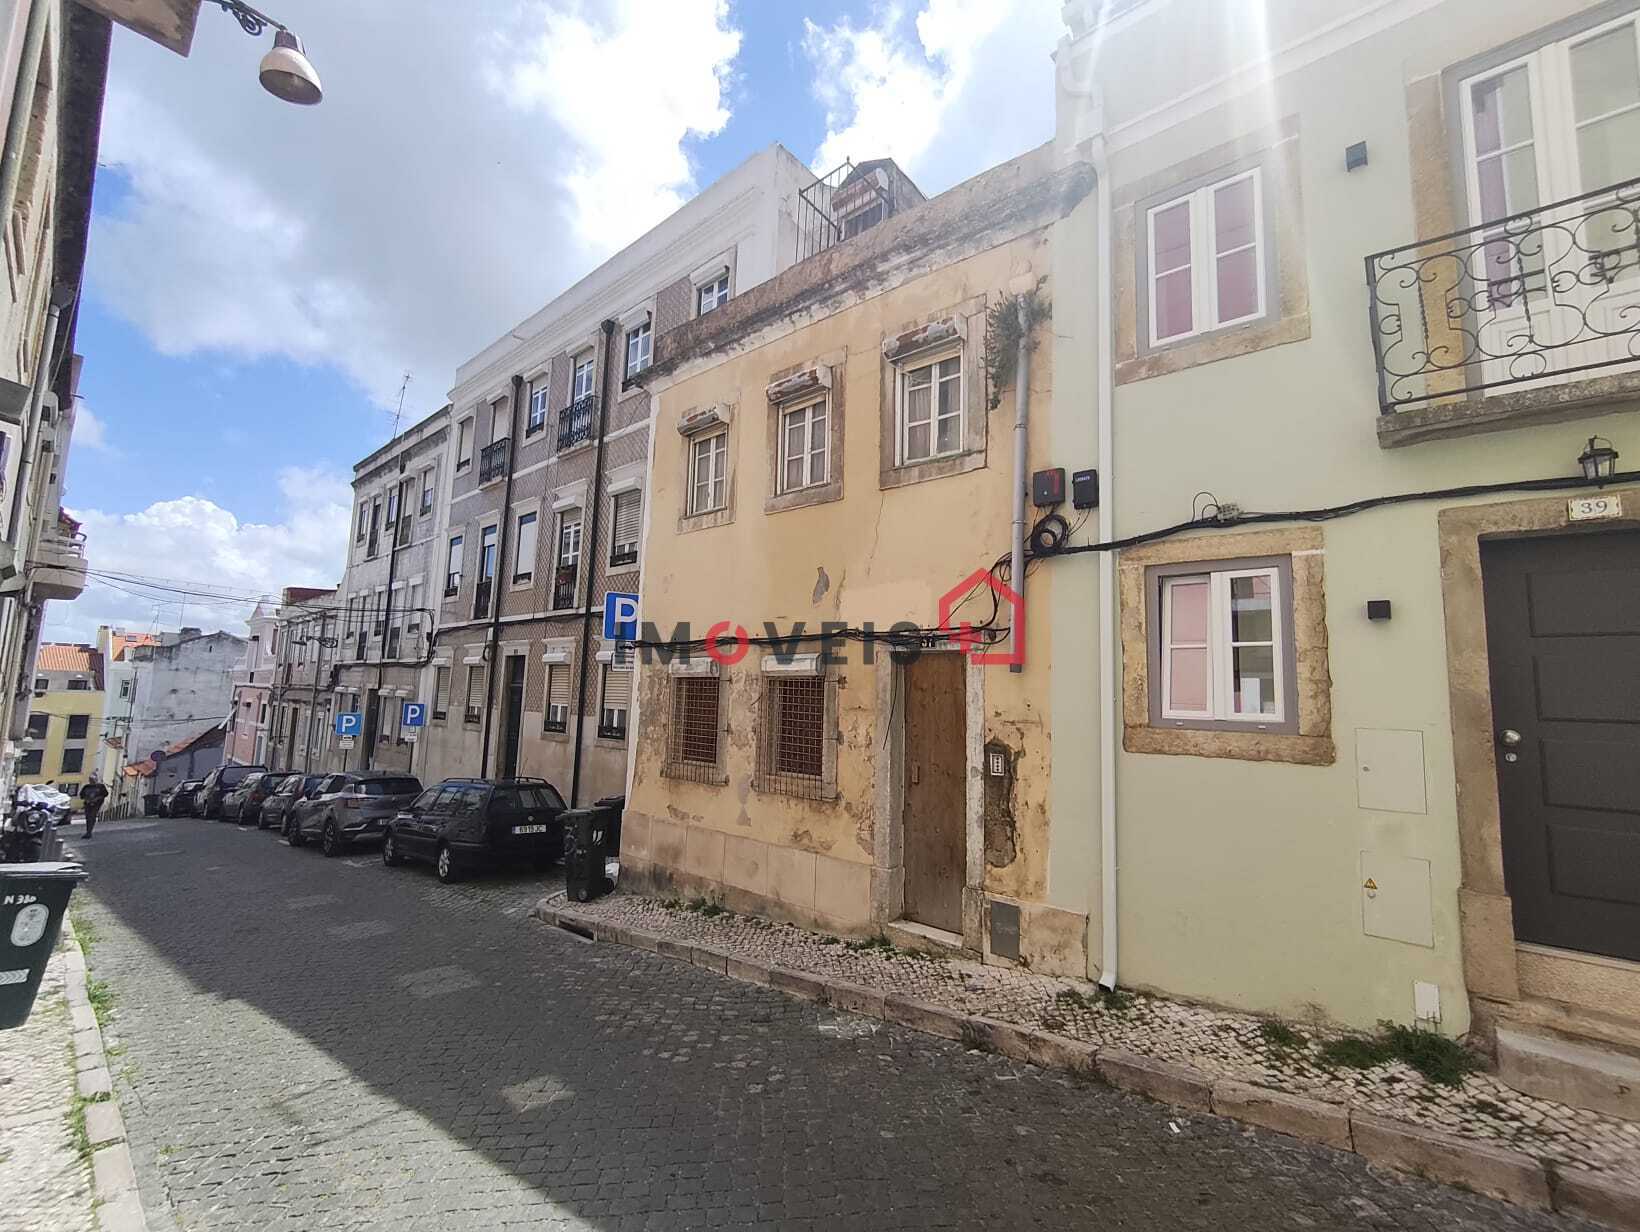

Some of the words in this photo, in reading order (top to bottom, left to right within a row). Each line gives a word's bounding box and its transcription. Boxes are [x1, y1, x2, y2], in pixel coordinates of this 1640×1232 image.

[1581, 500, 1608, 514] 39
[614, 597, 638, 636] P
[342, 715, 356, 732] P
[406, 705, 420, 724] P
